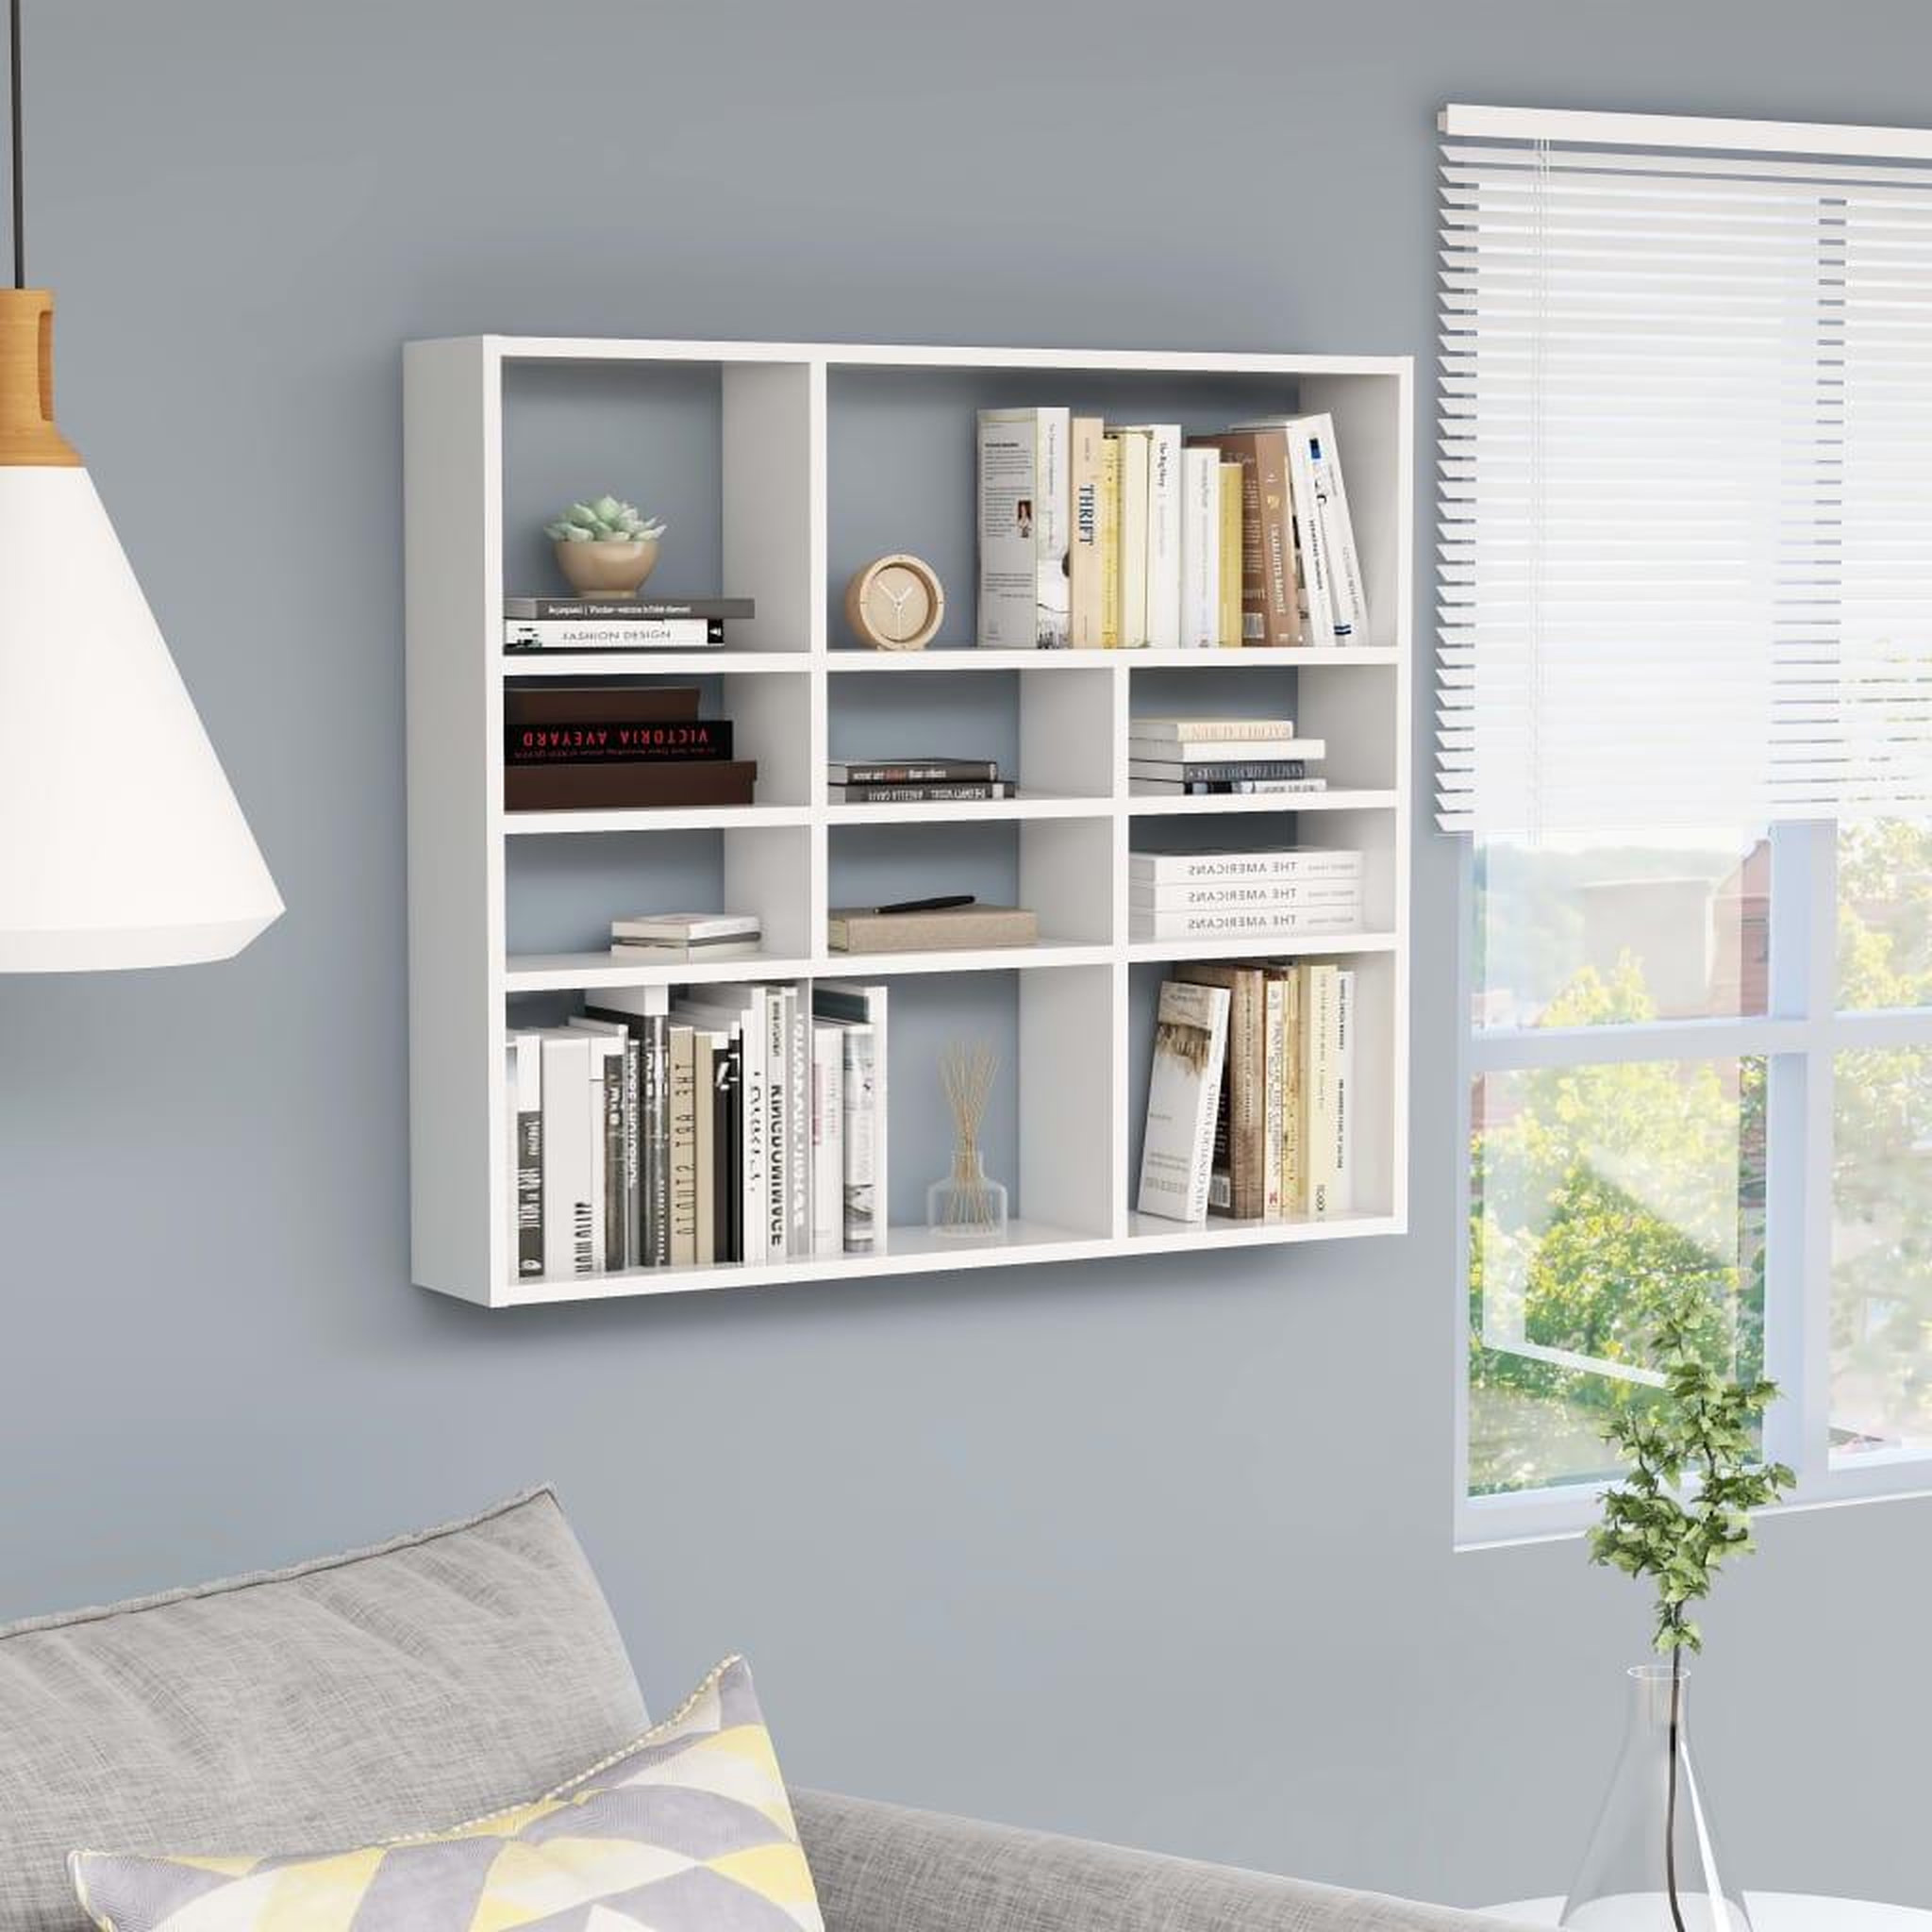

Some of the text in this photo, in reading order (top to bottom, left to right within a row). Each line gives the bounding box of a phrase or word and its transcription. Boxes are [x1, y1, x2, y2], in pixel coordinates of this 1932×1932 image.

[1079, 483, 1094, 546] THRIFT
[563, 629, 671, 641] FASHION DESIGN
[524, 727, 708, 746] VICTORIA AVEYARD
